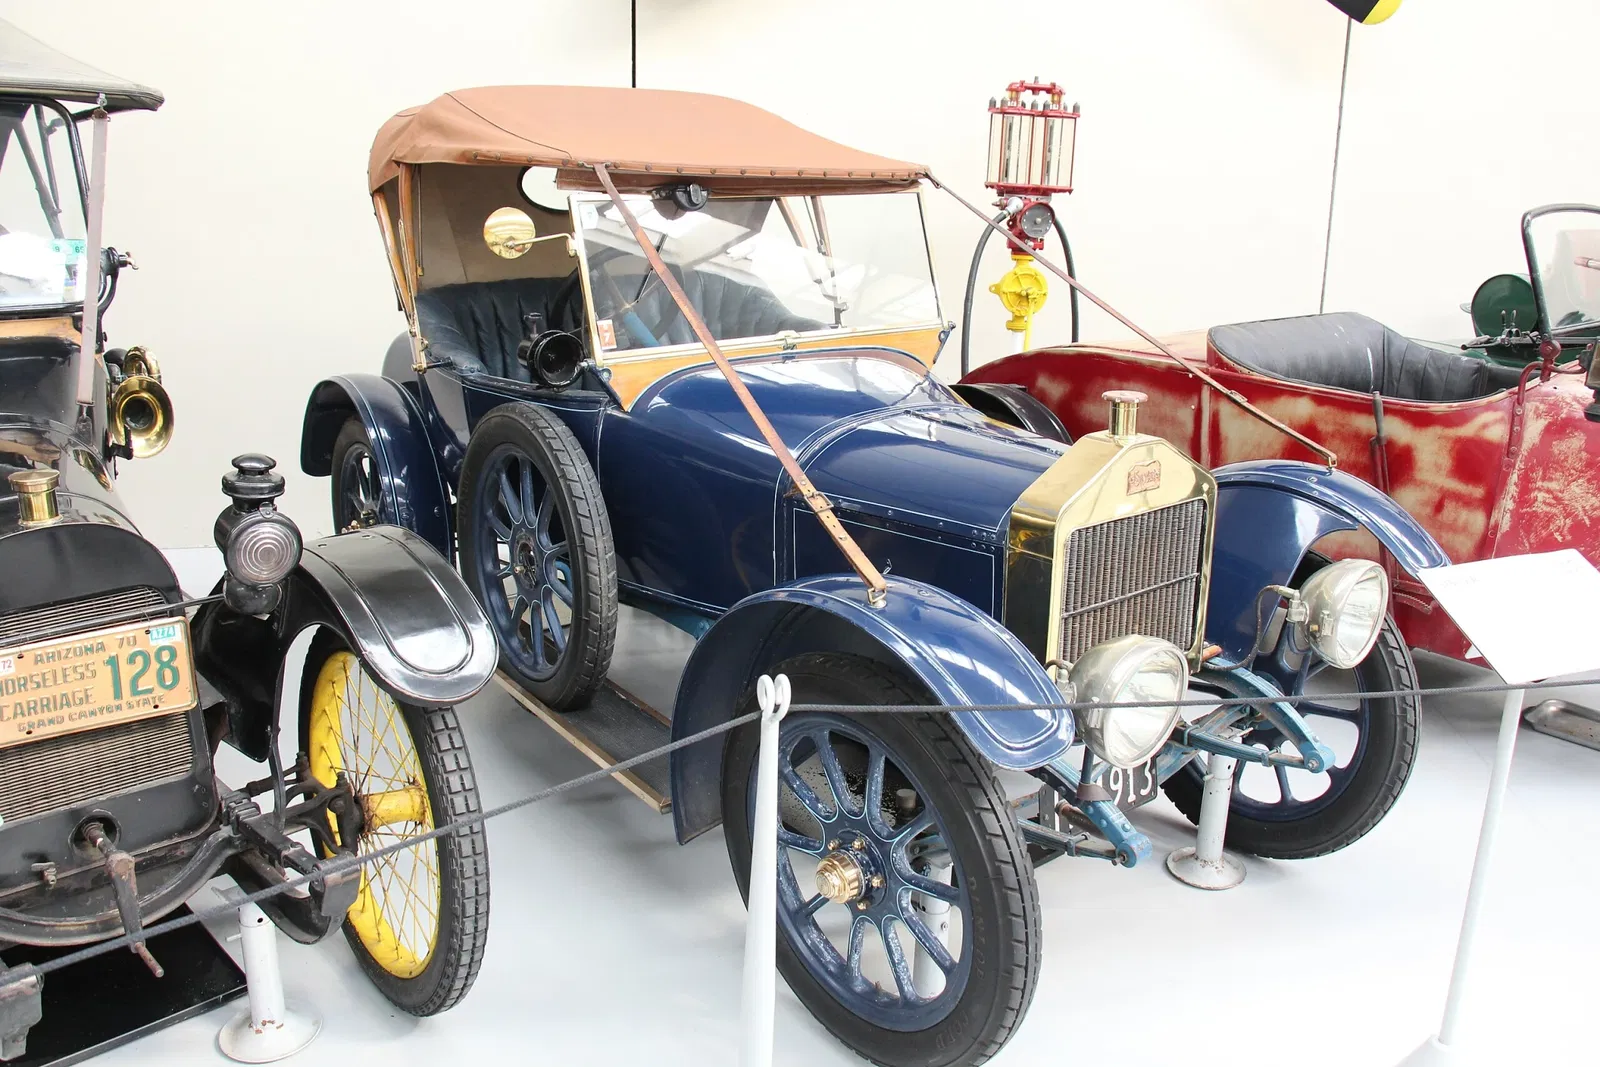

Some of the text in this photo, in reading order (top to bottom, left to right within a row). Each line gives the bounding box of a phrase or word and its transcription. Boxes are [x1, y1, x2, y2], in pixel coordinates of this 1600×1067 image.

[1, 659, 13, 670] 72
[34, 642, 105, 666] ARIZONA
[104, 645, 180, 700] 128
[0, 687, 97, 722] CARRIAGE
[18, 694, 165, 733] GRAND CANYON STATE
